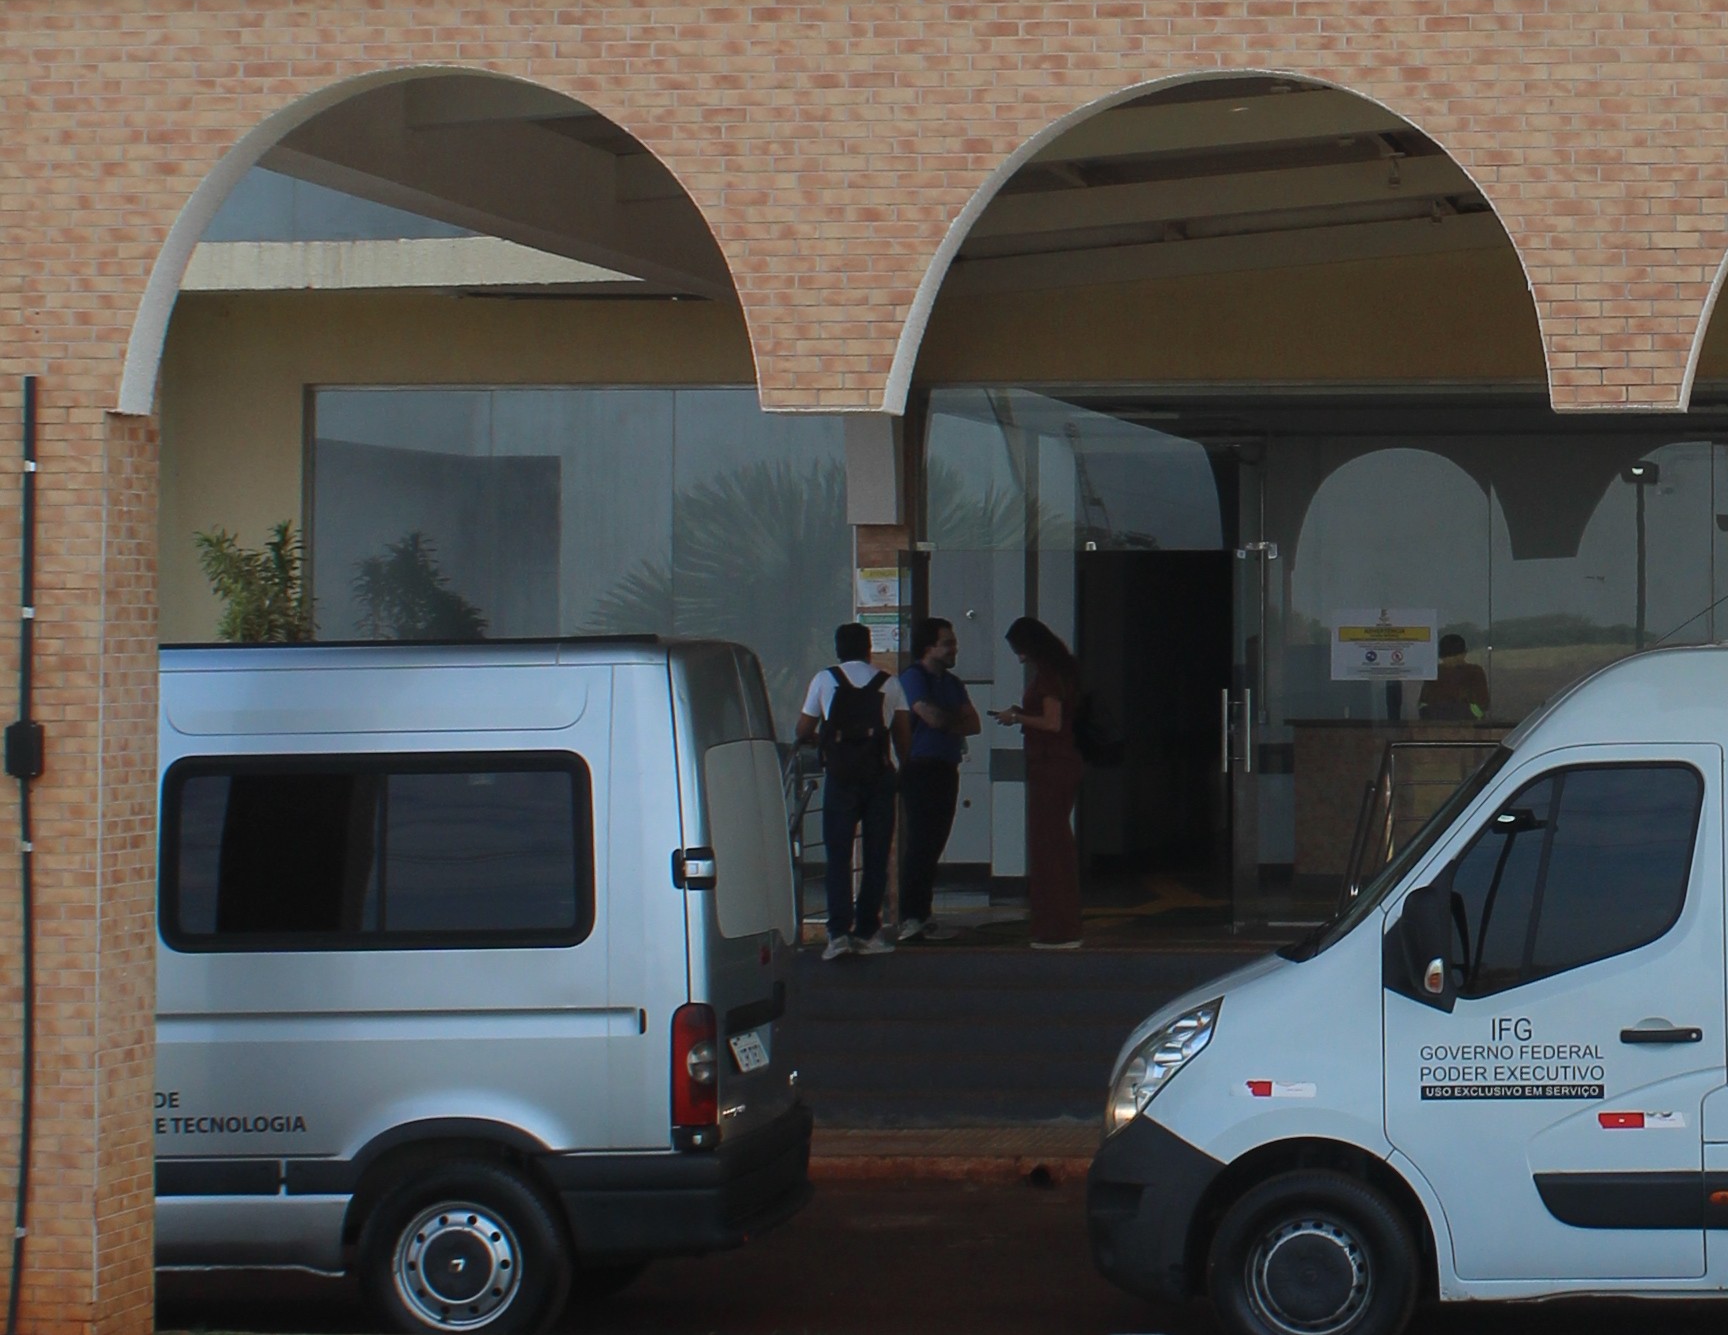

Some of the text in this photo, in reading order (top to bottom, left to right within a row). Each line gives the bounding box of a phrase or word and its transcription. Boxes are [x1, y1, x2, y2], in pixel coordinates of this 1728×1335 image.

[1491, 1018, 1533, 1041] IFG
[1420, 1045, 1604, 1061] GOVERNO FEDERAL
[1420, 1065, 1605, 1082] PODER EXECUTIVO
[154, 1092, 180, 1108] DE
[1426, 1086, 1599, 1098] USO EXCLUSIVO EM SERVIÇO
[172, 1115, 307, 1134] TECNOLOGIA
